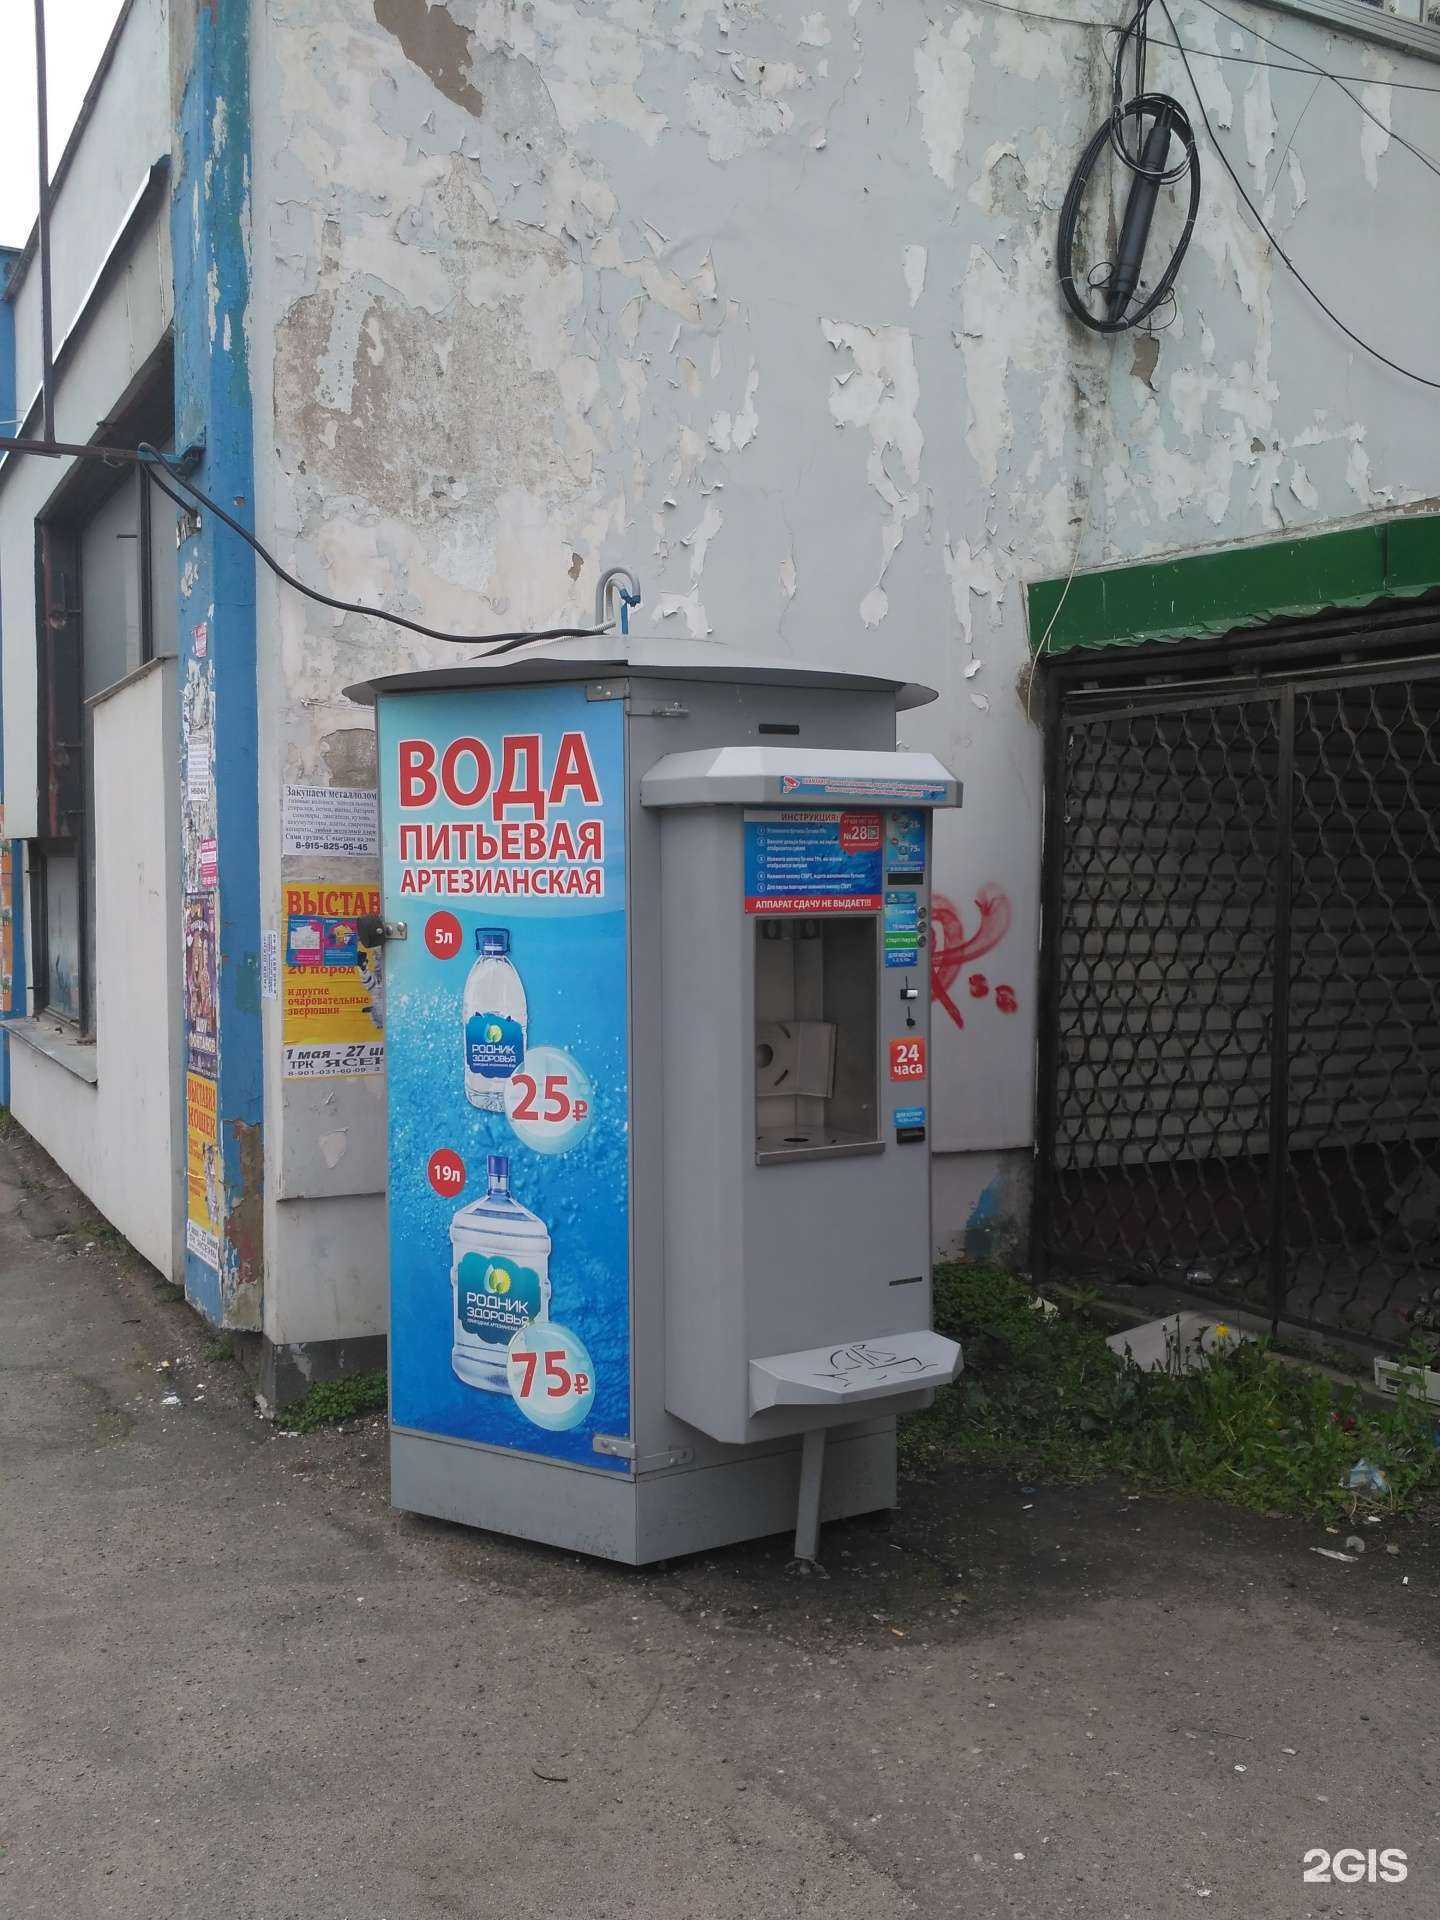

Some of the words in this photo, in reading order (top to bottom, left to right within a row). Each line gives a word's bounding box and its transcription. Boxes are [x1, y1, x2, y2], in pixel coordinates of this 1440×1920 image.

[398, 731, 602, 822] ВОДА
[295, 841, 368, 851] 8-915-825-05-45
[399, 820, 602, 862] ПИТЬЕВАЯ
[399, 868, 602, 895] АРТЕЗИАНСКАЯ
[755, 900, 792, 909] АППАРАТ
[794, 899, 821, 909] СДАЧУ
[821, 899, 833, 908] НЕ
[434, 928, 453, 945] 5л
[287, 996, 369, 1006] очаровательные
[297, 1050, 331, 1060] мая
[345, 1045, 366, 1058] 27
[471, 1043, 516, 1055] РОДНИК
[896, 1043, 920, 1063] 24
[290, 1060, 314, 1070] ТРК
[471, 1054, 517, 1064] ЗДОРОВЬЯ
[893, 1063, 924, 1076] часа
[433, 1164, 462, 1183] 19л
[465, 1291, 529, 1315] РОДНИК
[465, 1307, 530, 1326] ЗДОРОВЬЯ
